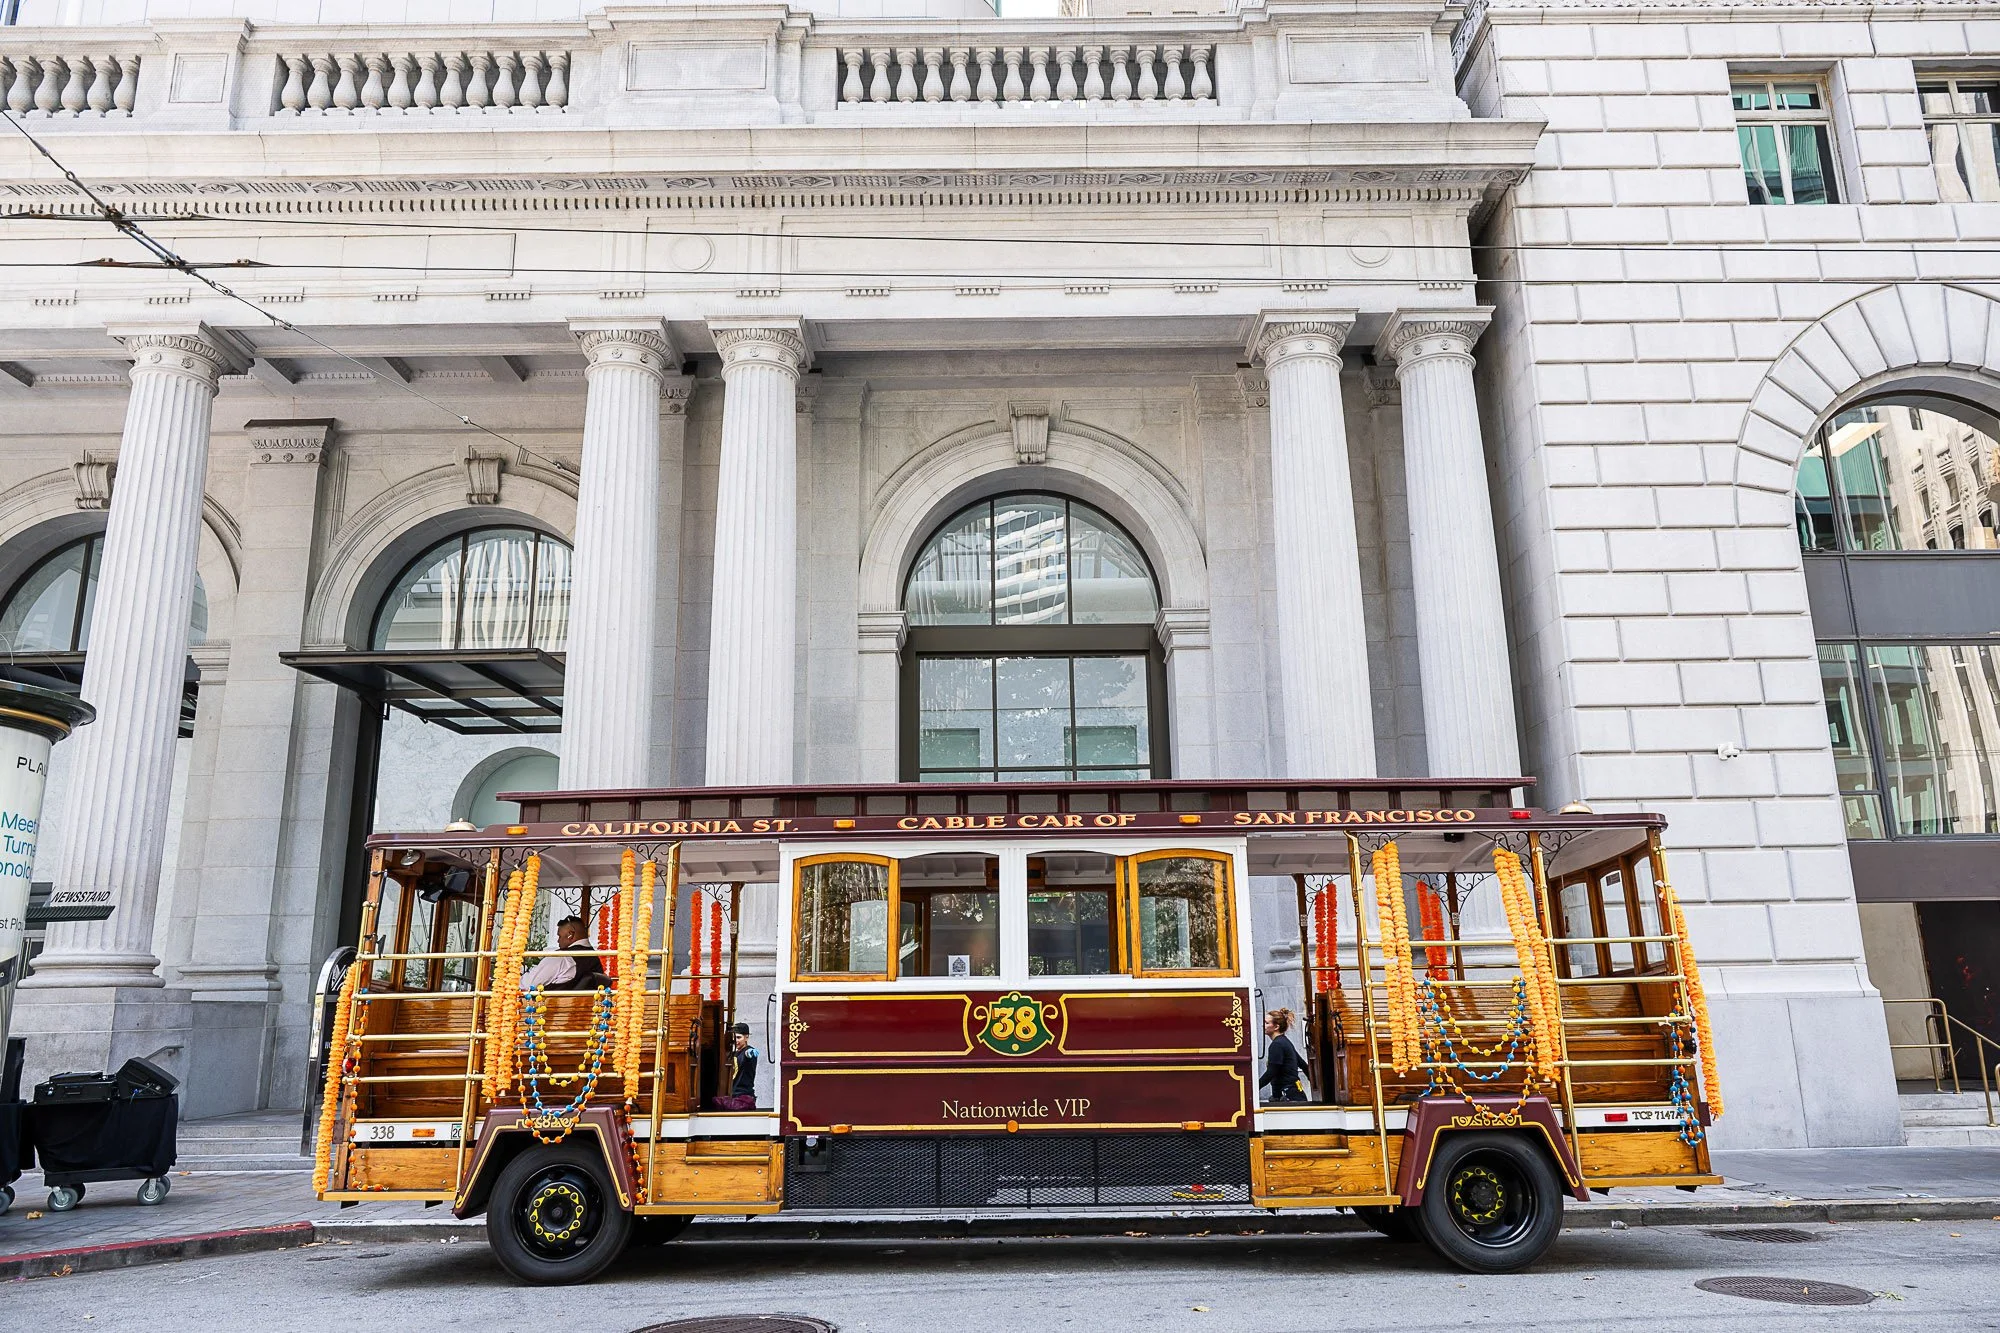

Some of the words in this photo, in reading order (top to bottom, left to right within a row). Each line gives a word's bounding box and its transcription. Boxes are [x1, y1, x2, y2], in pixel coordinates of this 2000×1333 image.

[561, 820, 743, 836] CALIFORNIA
[752, 818, 800, 834] ST.
[897, 816, 1006, 830] CABLE
[1018, 815, 1083, 829] CAR
[1093, 814, 1137, 828] OF
[1233, 810, 1296, 826] SAN
[1305, 809, 1476, 824] FRANCISCO
[51, 890, 111, 903] NEWSSTAND
[991, 1006, 1038, 1042] 38
[942, 1099, 1049, 1119] Nationwide
[1054, 1098, 1091, 1118] VIP
[1632, 1111, 1653, 1120] TCP
[370, 1125, 395, 1140] 338
